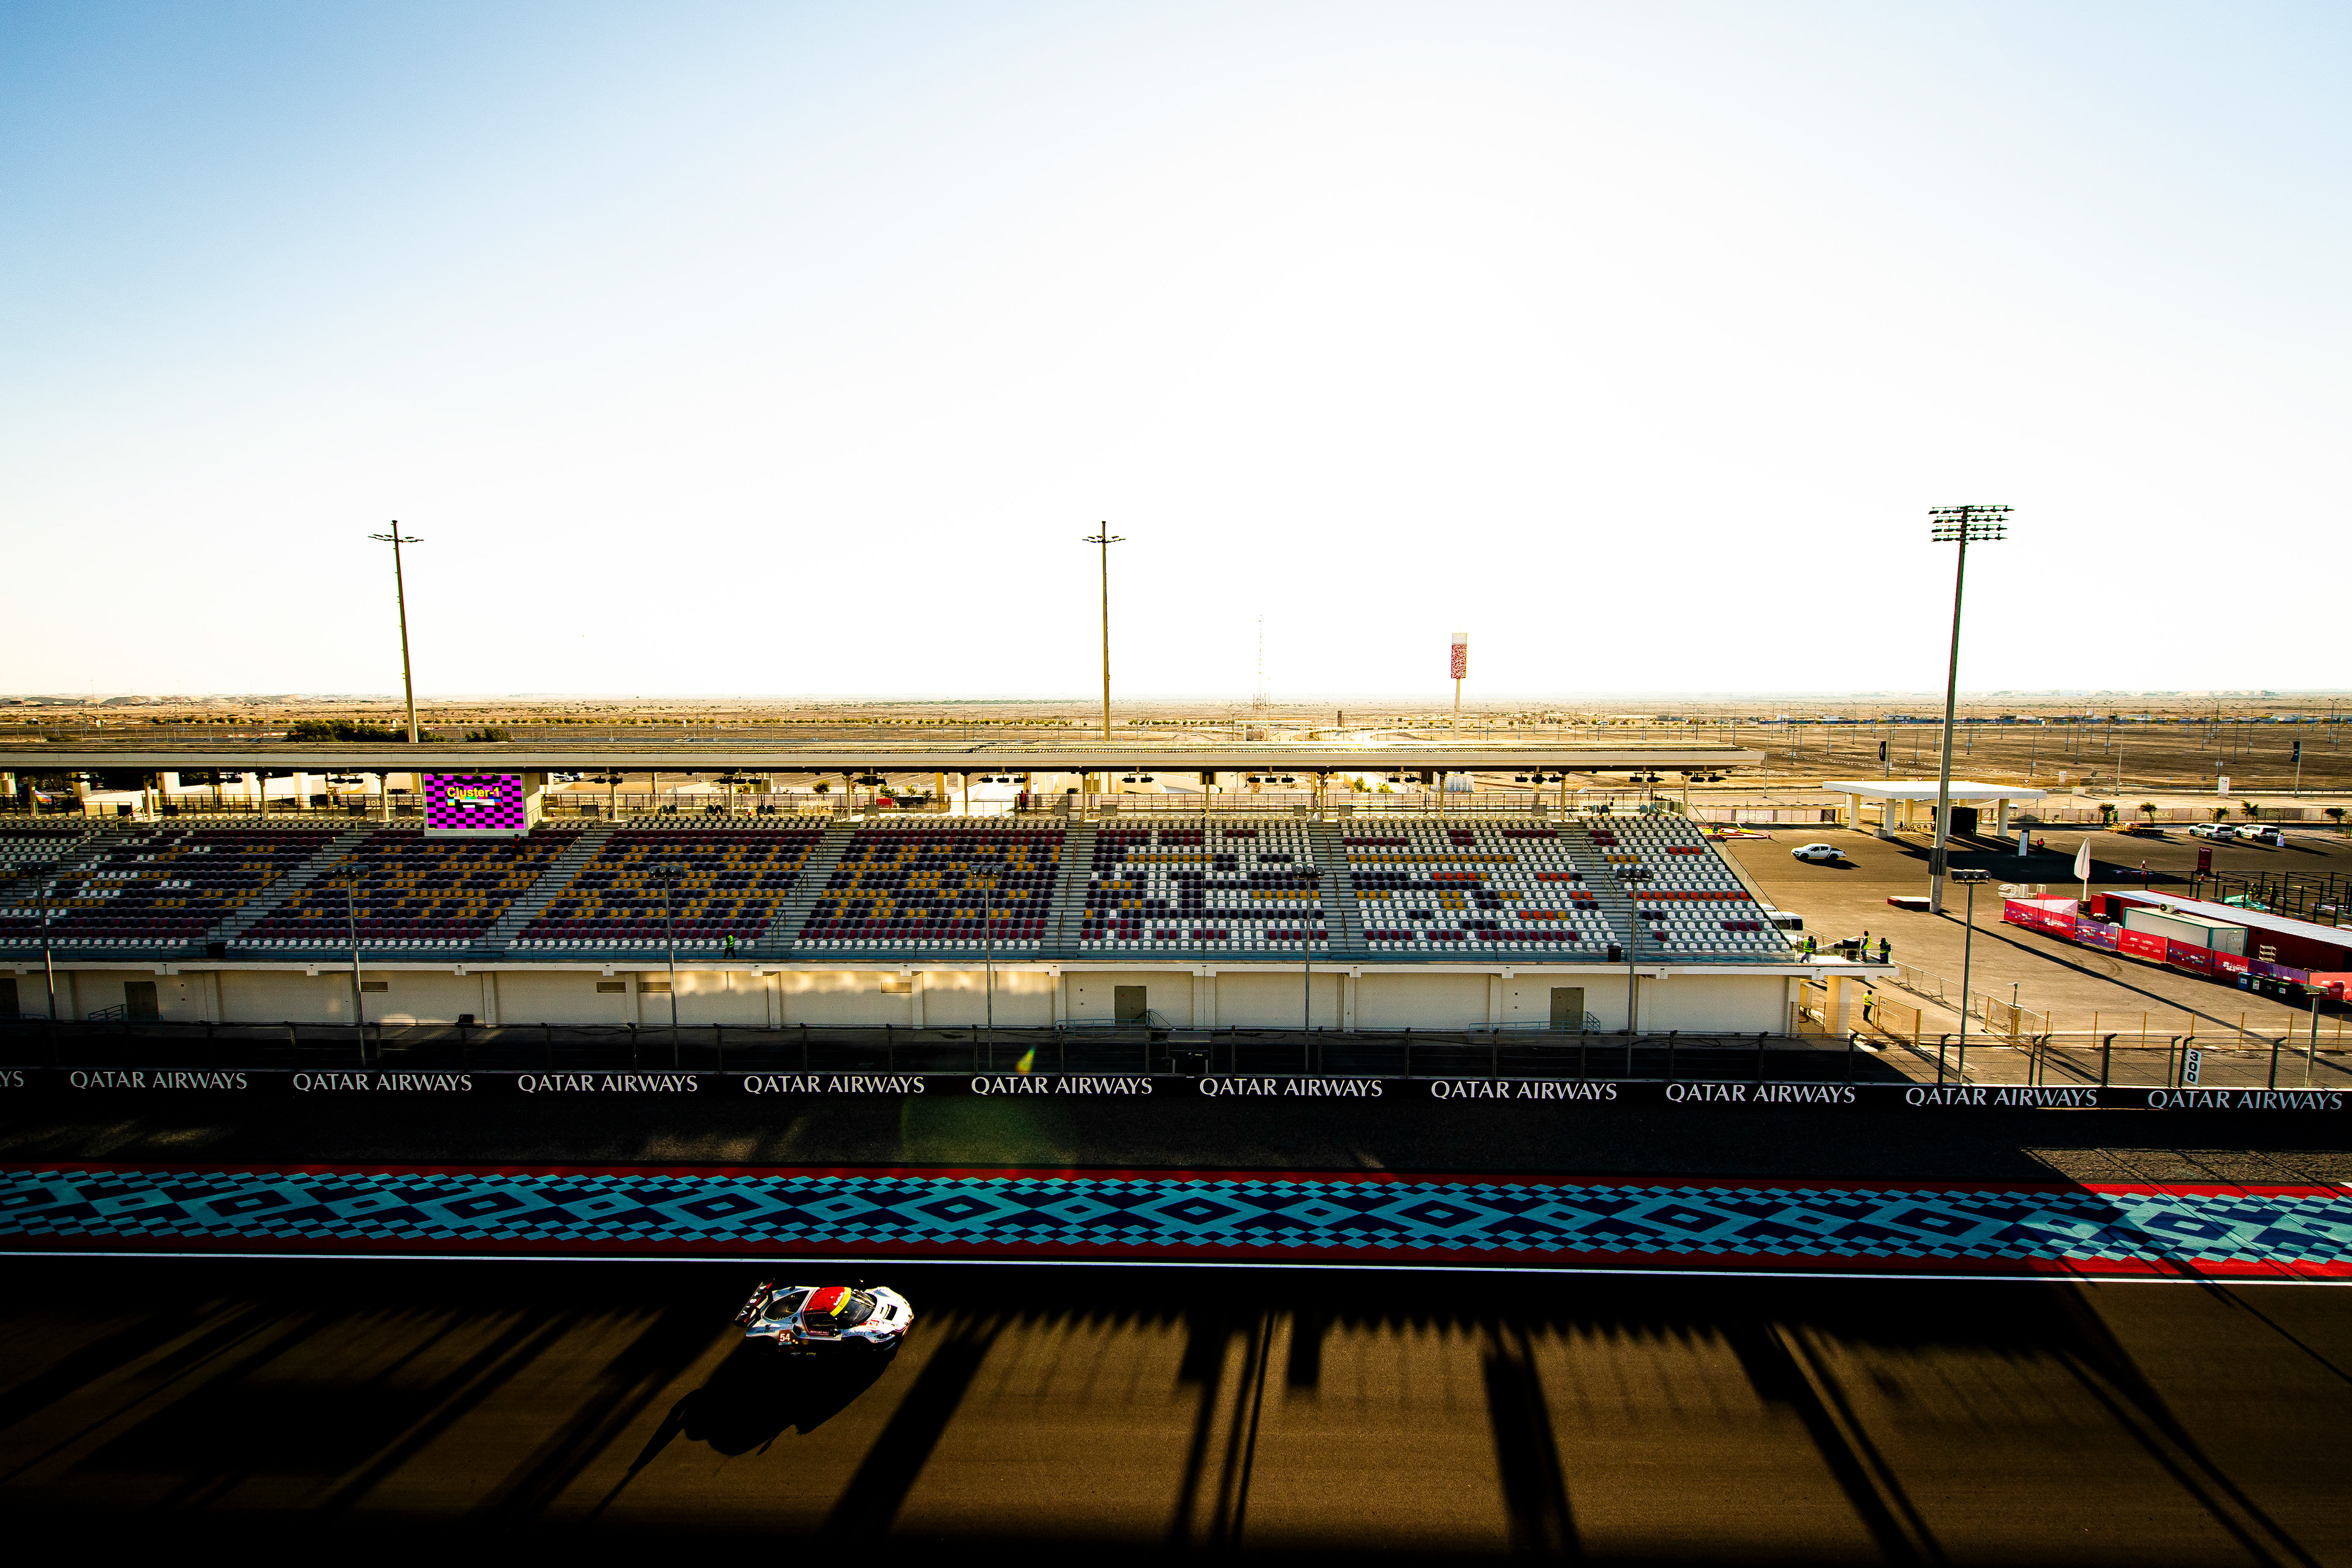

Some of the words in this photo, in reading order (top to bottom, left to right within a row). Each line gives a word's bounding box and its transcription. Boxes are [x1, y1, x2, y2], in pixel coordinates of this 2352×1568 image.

[447, 787, 500, 797] Cluster-1
[2187, 1051, 2199, 1082] 300
[0, 1071, 24, 1087] YS
[70, 1071, 146, 1088] QATAR
[153, 1072, 247, 1088] AIRWAYS
[293, 1073, 370, 1091] QATAR
[376, 1074, 472, 1091] AIRWAYS
[518, 1074, 595, 1093] QATAR
[601, 1075, 698, 1091] AIRWAYS
[744, 1076, 821, 1094] QATAR
[827, 1076, 925, 1093] AIRWAYS
[971, 1076, 1049, 1095] QATAR
[1055, 1077, 1152, 1094] AIRWAYS
[1199, 1078, 1277, 1096] QATAR
[1284, 1079, 1382, 1096] AIRWAYS
[1431, 1080, 1510, 1099] QATAR
[1517, 1082, 1617, 1099] AIRWAYS
[1666, 1084, 1746, 1102] QATAR
[1752, 1085, 1855, 1103] AIRWAYS
[1905, 1087, 1987, 1106] QATAR
[1994, 1088, 2097, 1106] AIRWAYS
[2147, 1090, 2230, 1110] QATAR
[2237, 1091, 2343, 1109] AIRWAYS
[740, 1286, 767, 1316] VISTA
[780, 1333, 790, 1342] 54
